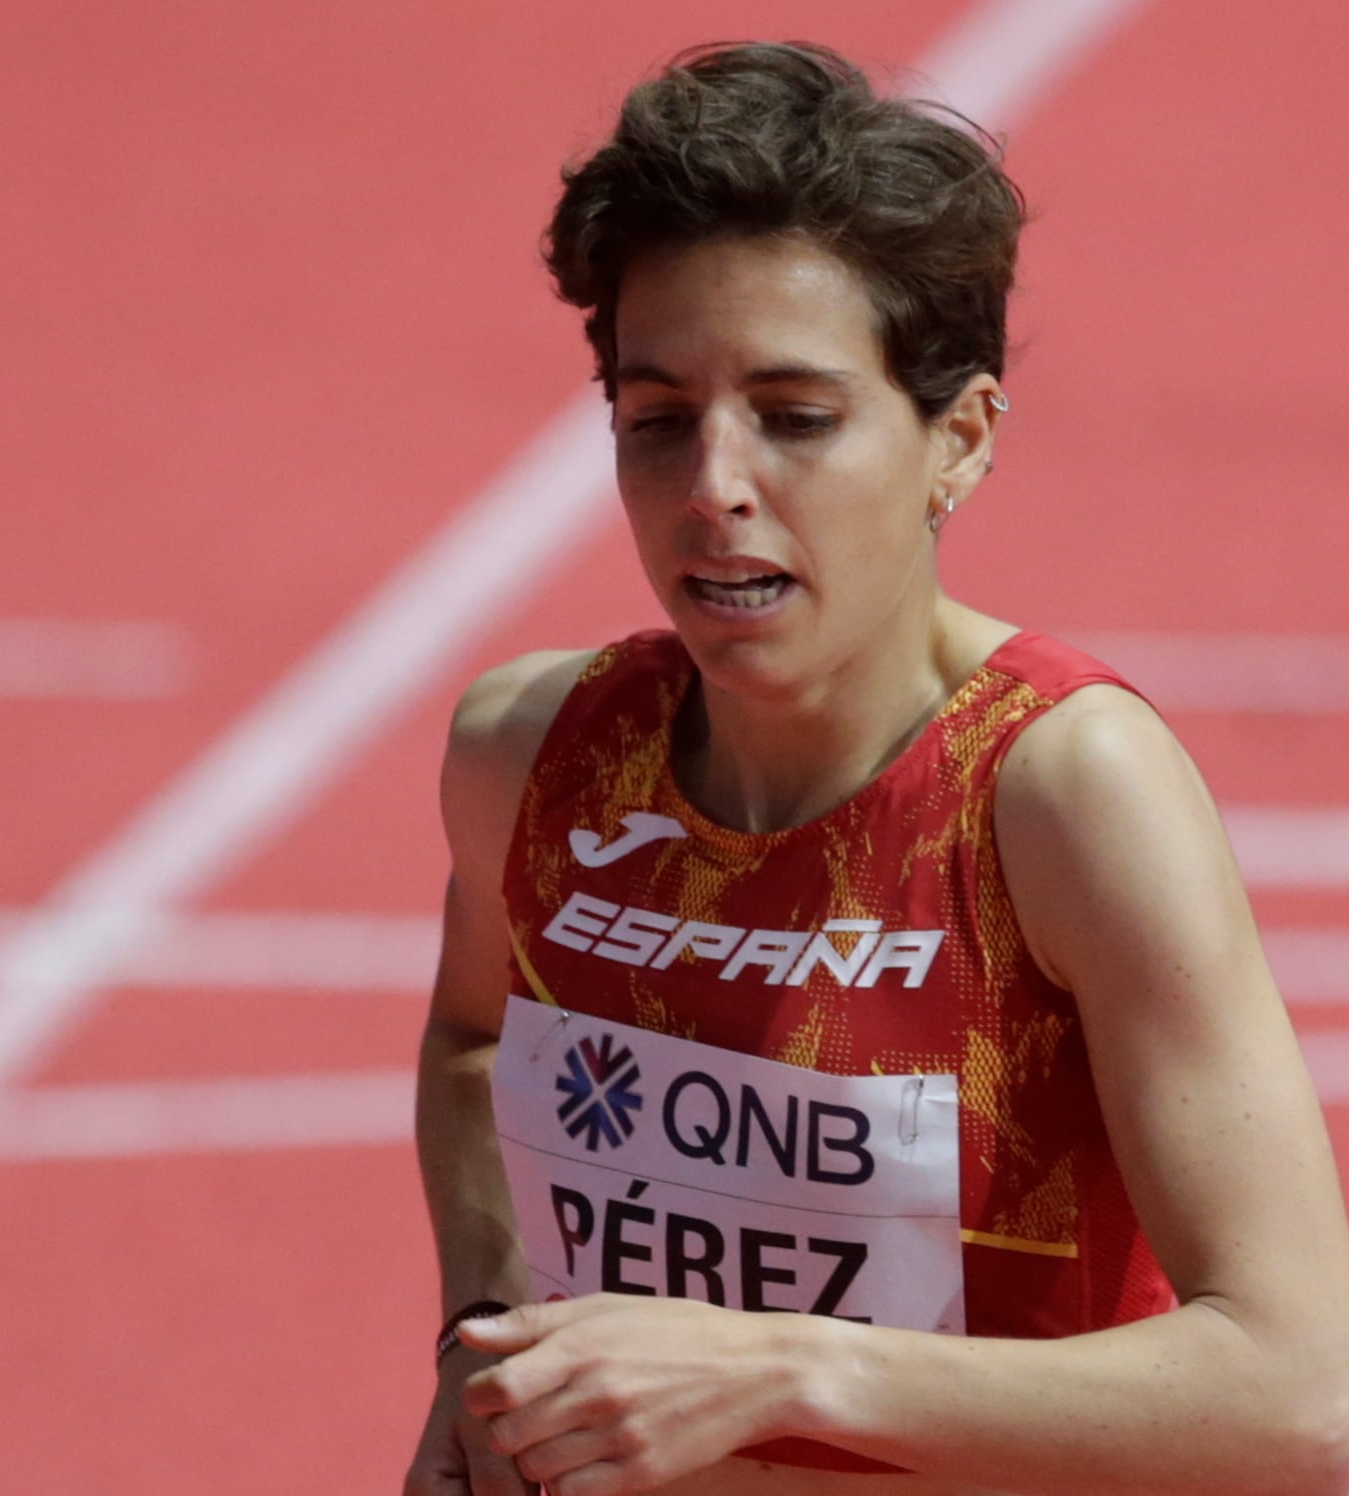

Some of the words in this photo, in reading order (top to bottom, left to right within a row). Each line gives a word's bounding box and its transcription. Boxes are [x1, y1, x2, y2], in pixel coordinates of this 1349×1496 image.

[542, 891, 946, 989] ESPAÑA
[661, 1070, 876, 1187] QNB
[550, 1180, 873, 1325] PÉREZ
